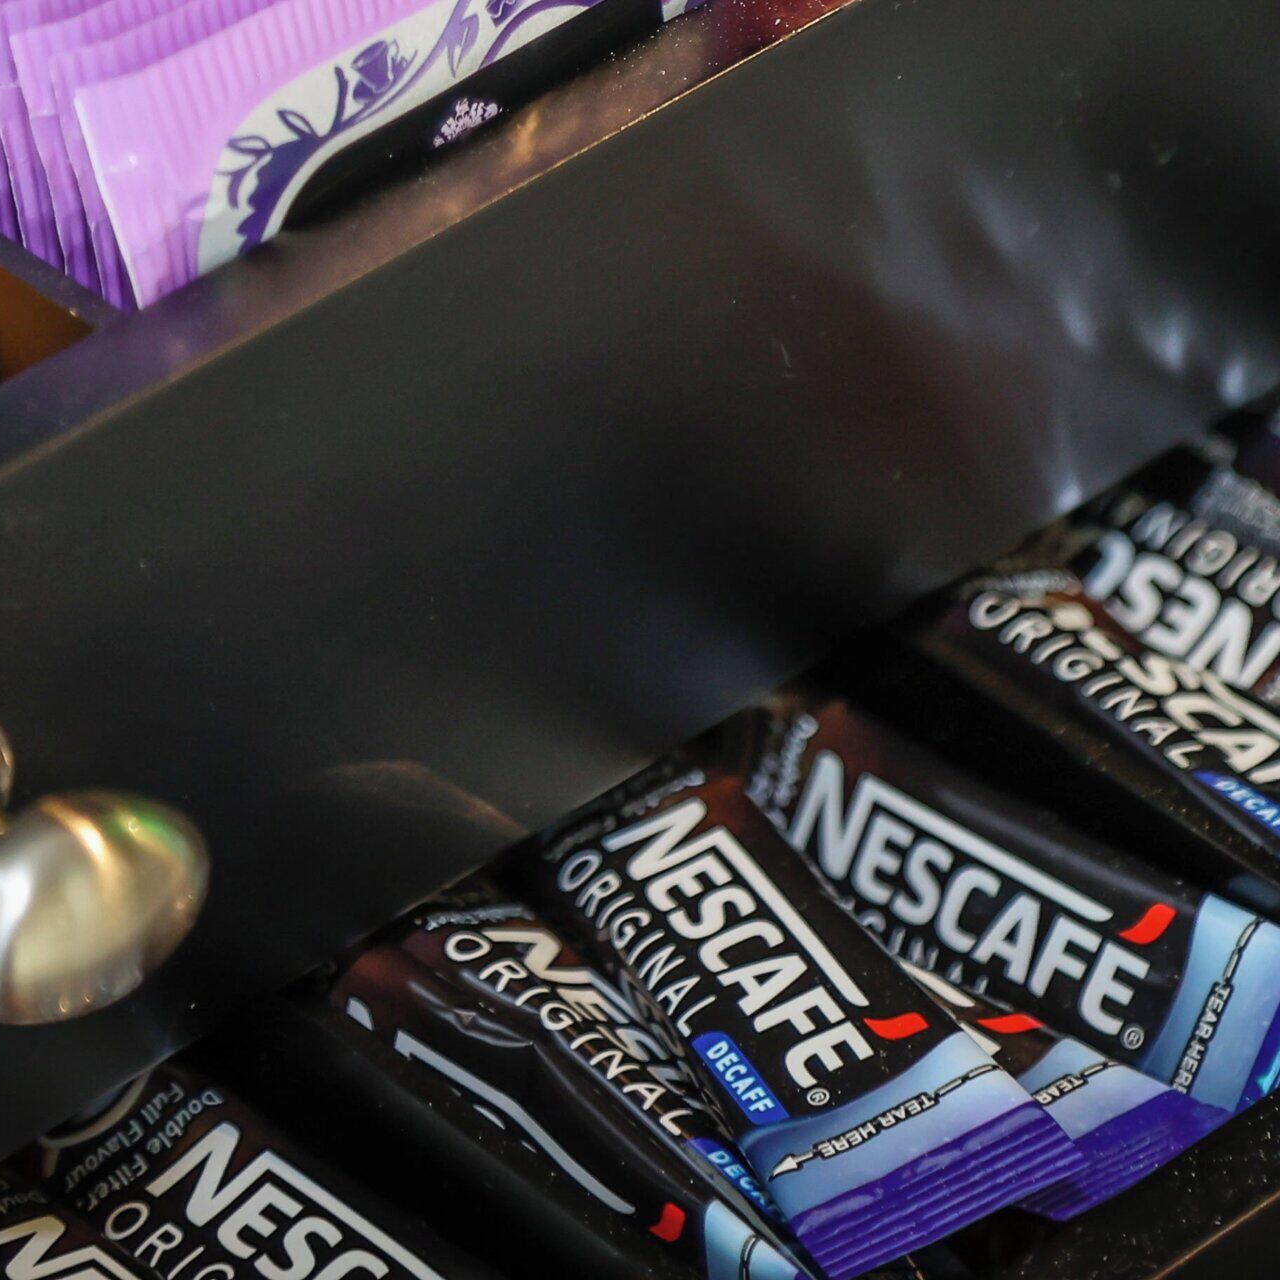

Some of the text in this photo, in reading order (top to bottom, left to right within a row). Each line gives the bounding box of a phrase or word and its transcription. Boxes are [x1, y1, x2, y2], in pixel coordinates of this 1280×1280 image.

[969, 590, 1204, 769] ORIGINAL
[557, 849, 716, 1038] ORIGINAL
[444, 931, 693, 1136] ORIGINAL
[1195, 984, 1230, 1039] TEAR
[705, 1040, 774, 1115] DECAFF
[1032, 1077, 1085, 1105] TEAR
[64, 1081, 185, 1192] Full Flavour
[146, 1090, 225, 1155] Double
[817, 1094, 936, 1158] TEAR HERE
